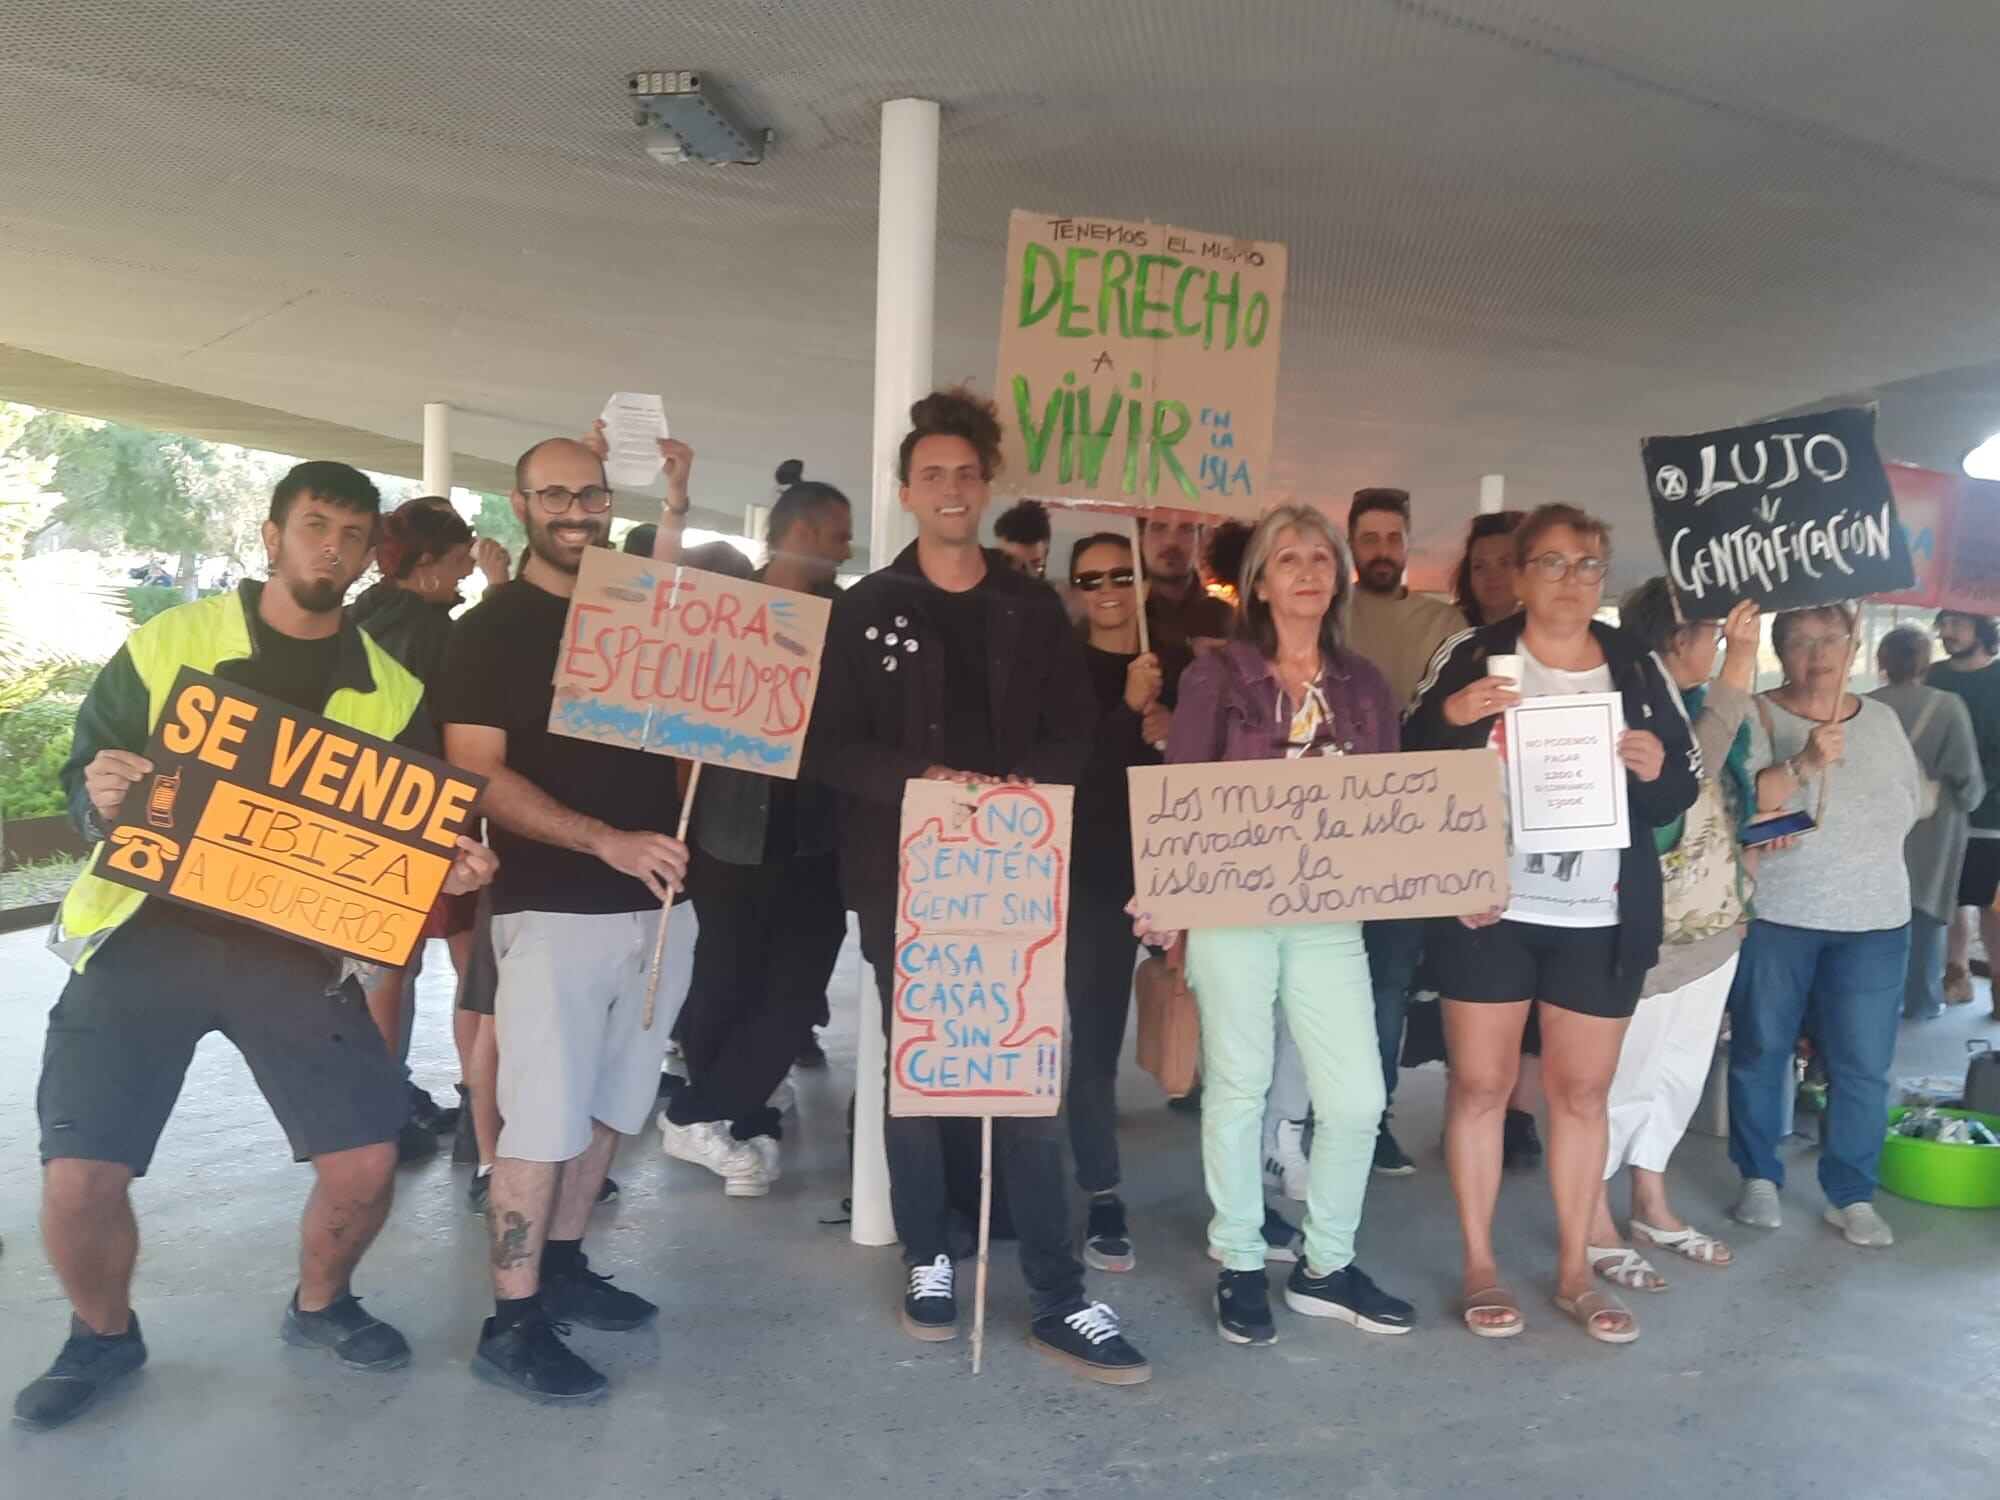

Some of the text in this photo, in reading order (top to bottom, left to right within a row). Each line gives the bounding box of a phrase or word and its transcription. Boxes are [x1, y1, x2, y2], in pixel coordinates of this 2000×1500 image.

[1048, 219, 1265, 267] TENEMOS EL MISMO
[1018, 242, 1270, 351] DERECHO
[1091, 351, 1114, 373] A
[1200, 453, 1252, 496] ISLA
[1694, 433, 1849, 505] LUJO
[651, 580, 769, 646] FORA
[162, 684, 479, 849] SE VENDE
[985, 800, 1043, 837] NO
[1146, 766, 1439, 825] Los mega ricos
[222, 798, 411, 896] IBIZA
[1140, 794, 1486, 860] invaden la isla los
[1147, 842, 1343, 898] isleños la
[1266, 867, 1496, 917] abandonan
[179, 851, 405, 953] A USUREROS
[910, 890, 1053, 925] GENT SIN
[900, 942, 985, 977] CASA
[903, 981, 1010, 1024] CASAS
[943, 1018, 991, 1049] SIN
[907, 1049, 1022, 1089] GENT
